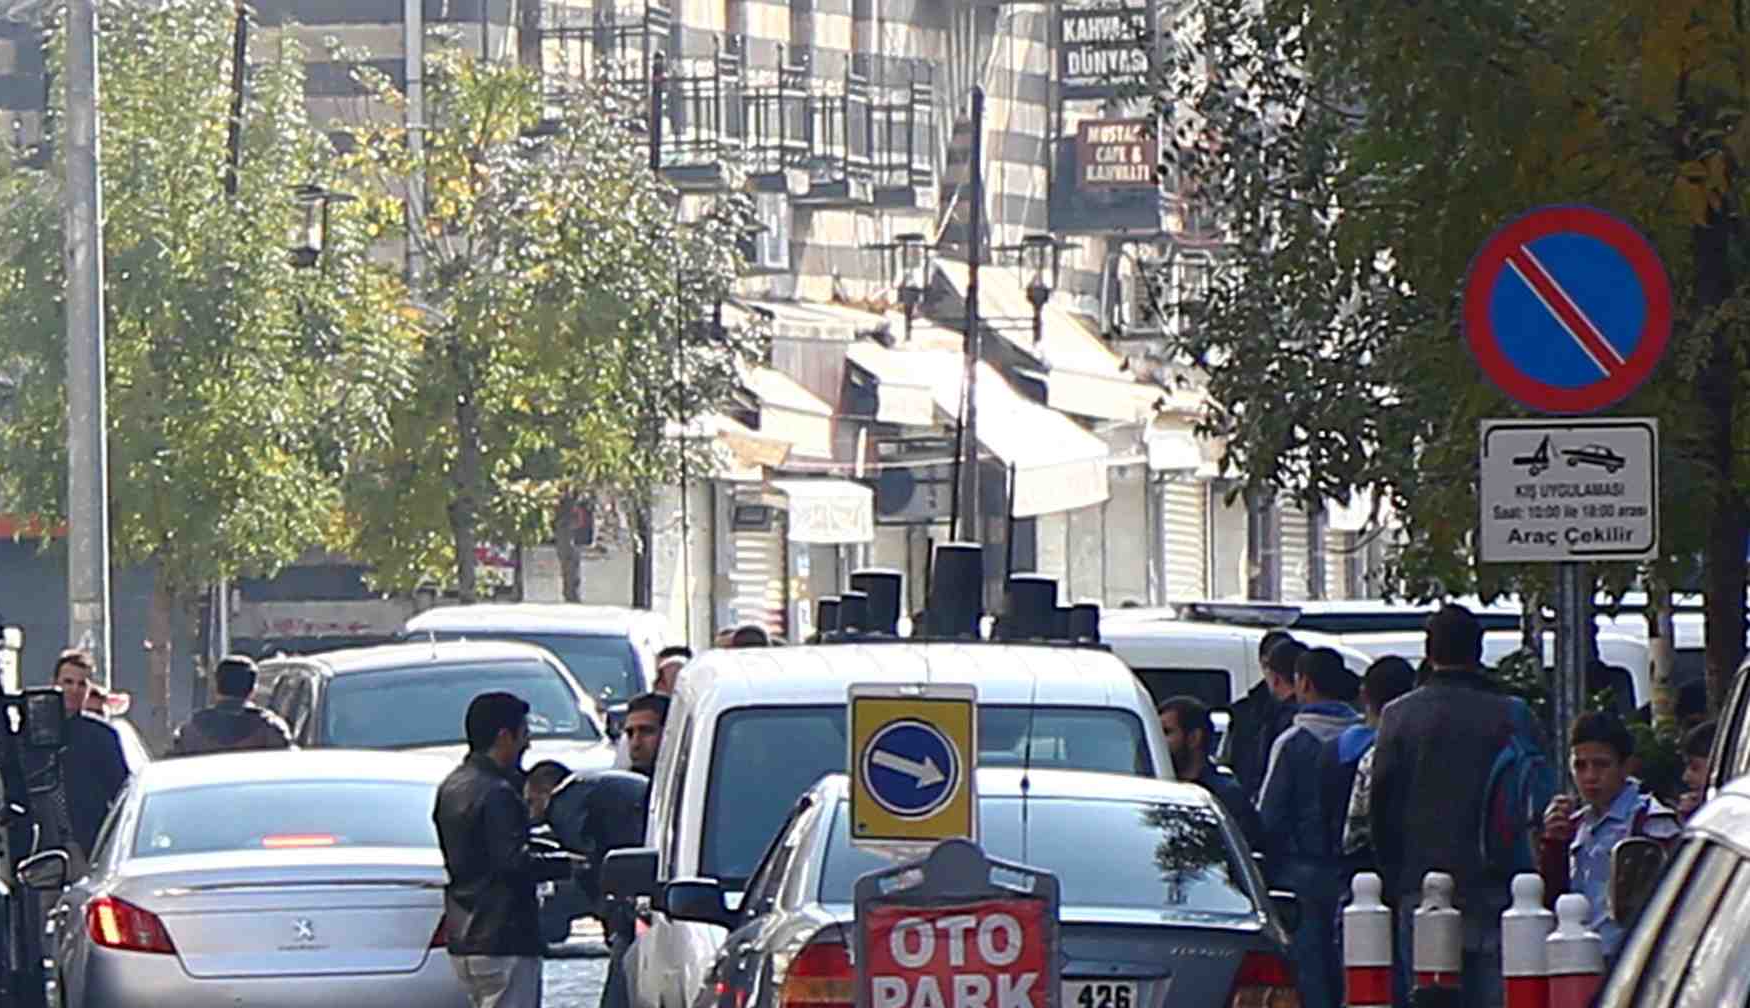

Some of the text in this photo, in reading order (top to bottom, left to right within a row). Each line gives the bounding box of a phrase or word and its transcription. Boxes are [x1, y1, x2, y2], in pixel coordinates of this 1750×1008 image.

[1508, 526, 1633, 545] Araç Çekilir
[890, 913, 1023, 968] OTO
